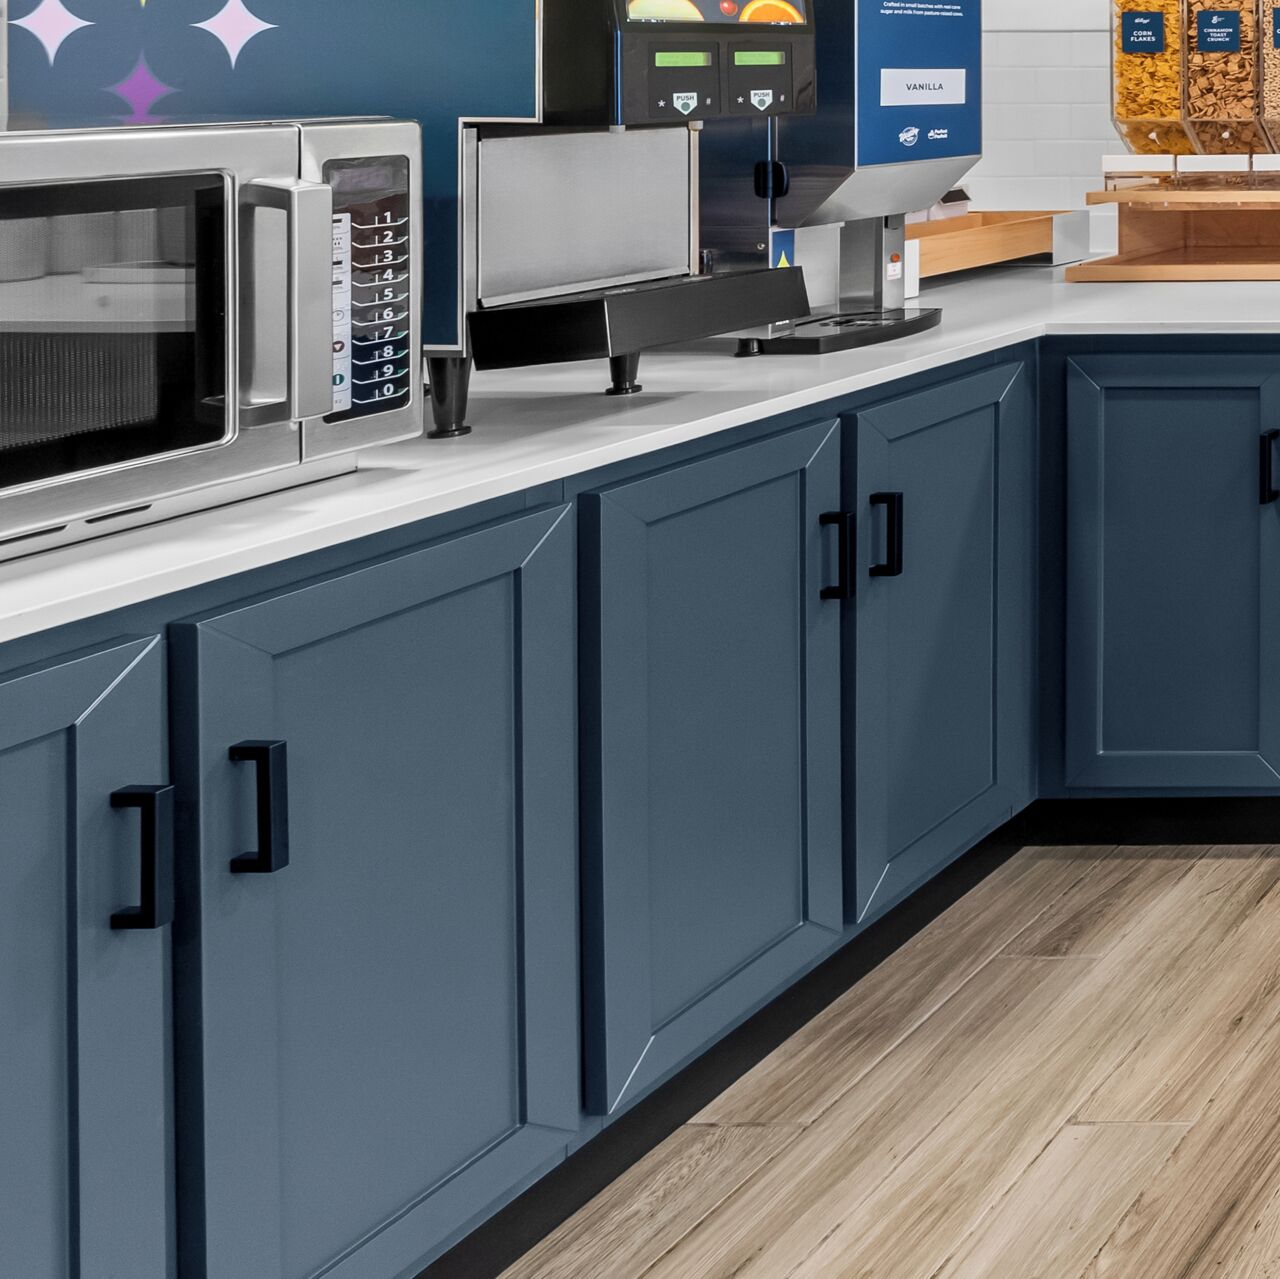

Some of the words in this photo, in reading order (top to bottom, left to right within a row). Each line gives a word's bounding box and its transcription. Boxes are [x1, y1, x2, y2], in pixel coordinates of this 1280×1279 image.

[905, 83, 944, 91] VANILLA
[676, 94, 695, 102] PUSH
[383, 211, 391, 223] 1
[383, 230, 394, 243] 2
[383, 249, 393, 262] 3
[382, 268, 394, 280] 4
[383, 287, 393, 300] 5
[383, 307, 393, 320] 6
[383, 326, 393, 338] 7
[383, 345, 394, 357] 8
[383, 364, 394, 377] 9
[383, 383, 394, 396] 0
